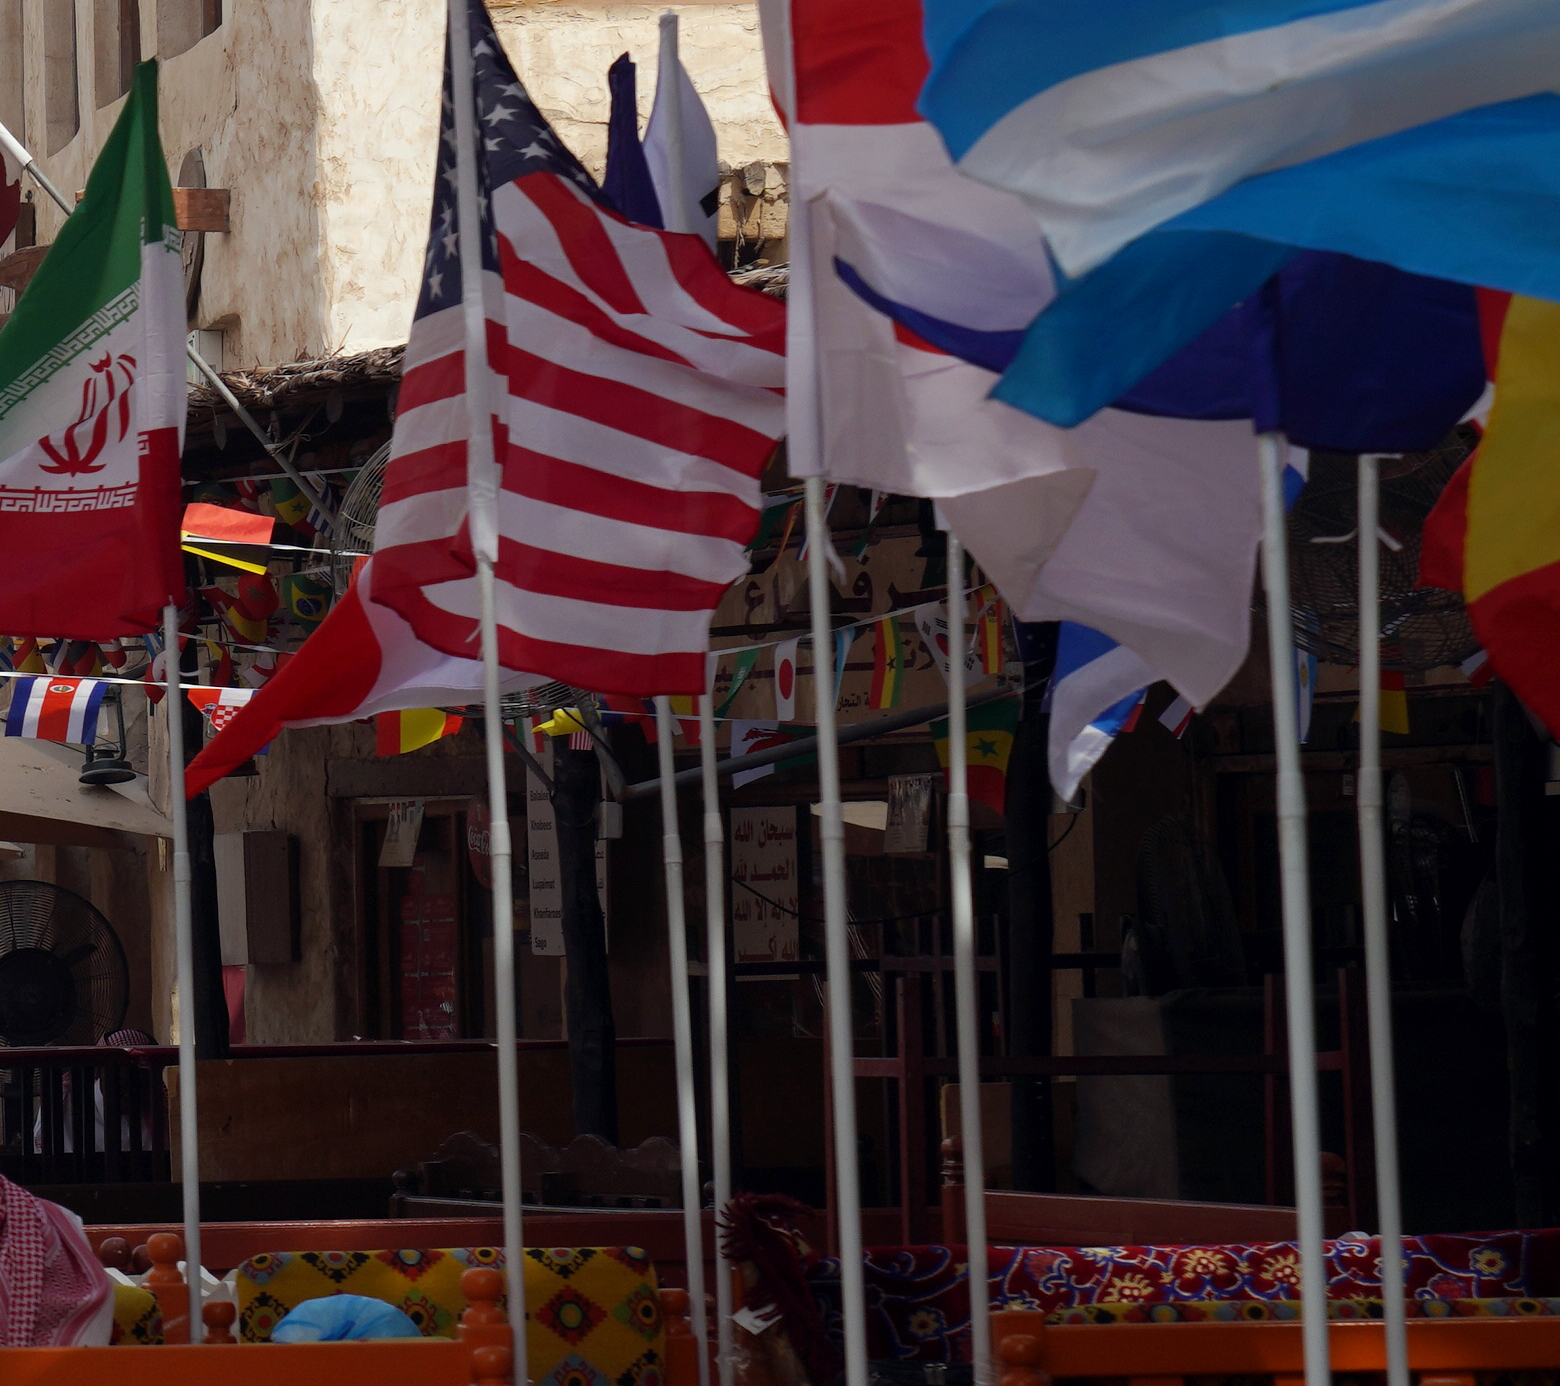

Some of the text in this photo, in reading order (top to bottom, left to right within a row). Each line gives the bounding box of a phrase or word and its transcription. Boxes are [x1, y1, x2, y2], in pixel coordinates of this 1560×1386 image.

[735, 819, 793, 848] سبحان الله
[750, 858, 795, 882] الحمد
